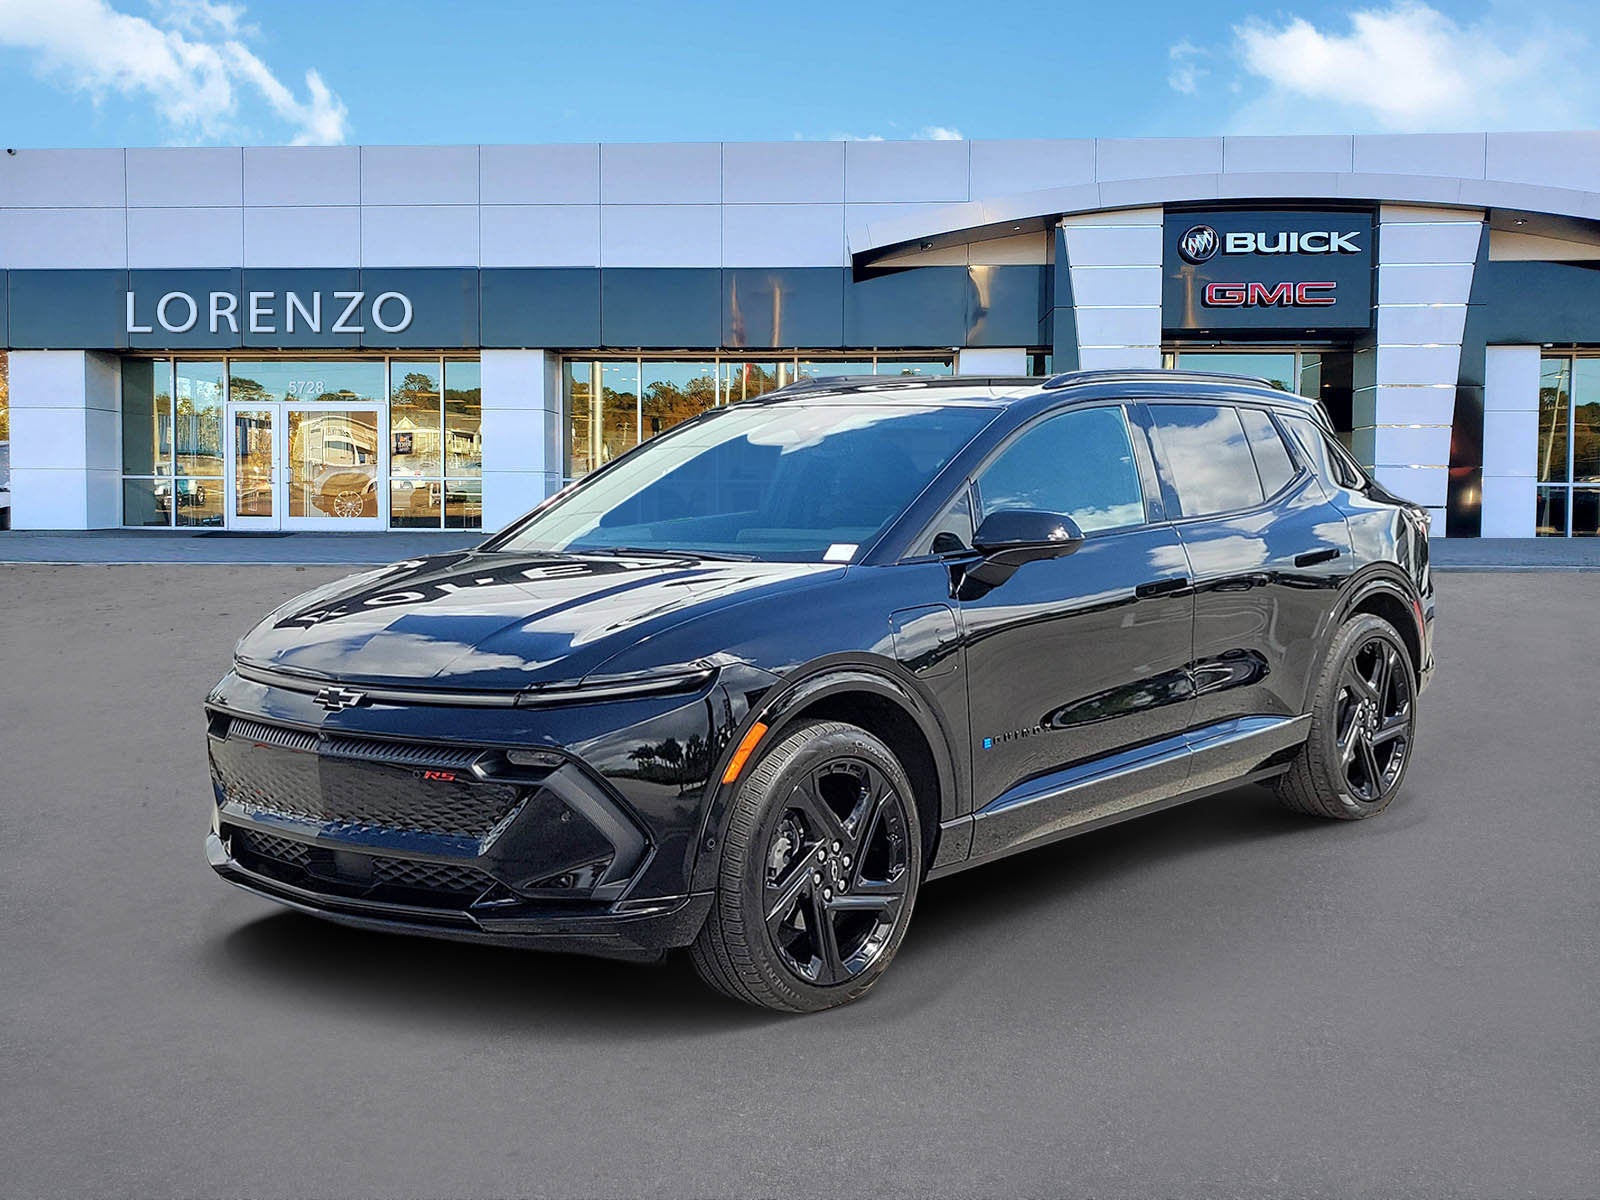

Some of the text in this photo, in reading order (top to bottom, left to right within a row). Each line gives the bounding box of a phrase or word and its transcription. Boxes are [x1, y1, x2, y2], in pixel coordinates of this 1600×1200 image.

[1225, 231, 1362, 253] BUICK
[1205, 281, 1337, 305] GMC
[126, 291, 413, 333] LORENZO
[288, 381, 324, 394] 5728
[423, 770, 456, 781] RS
